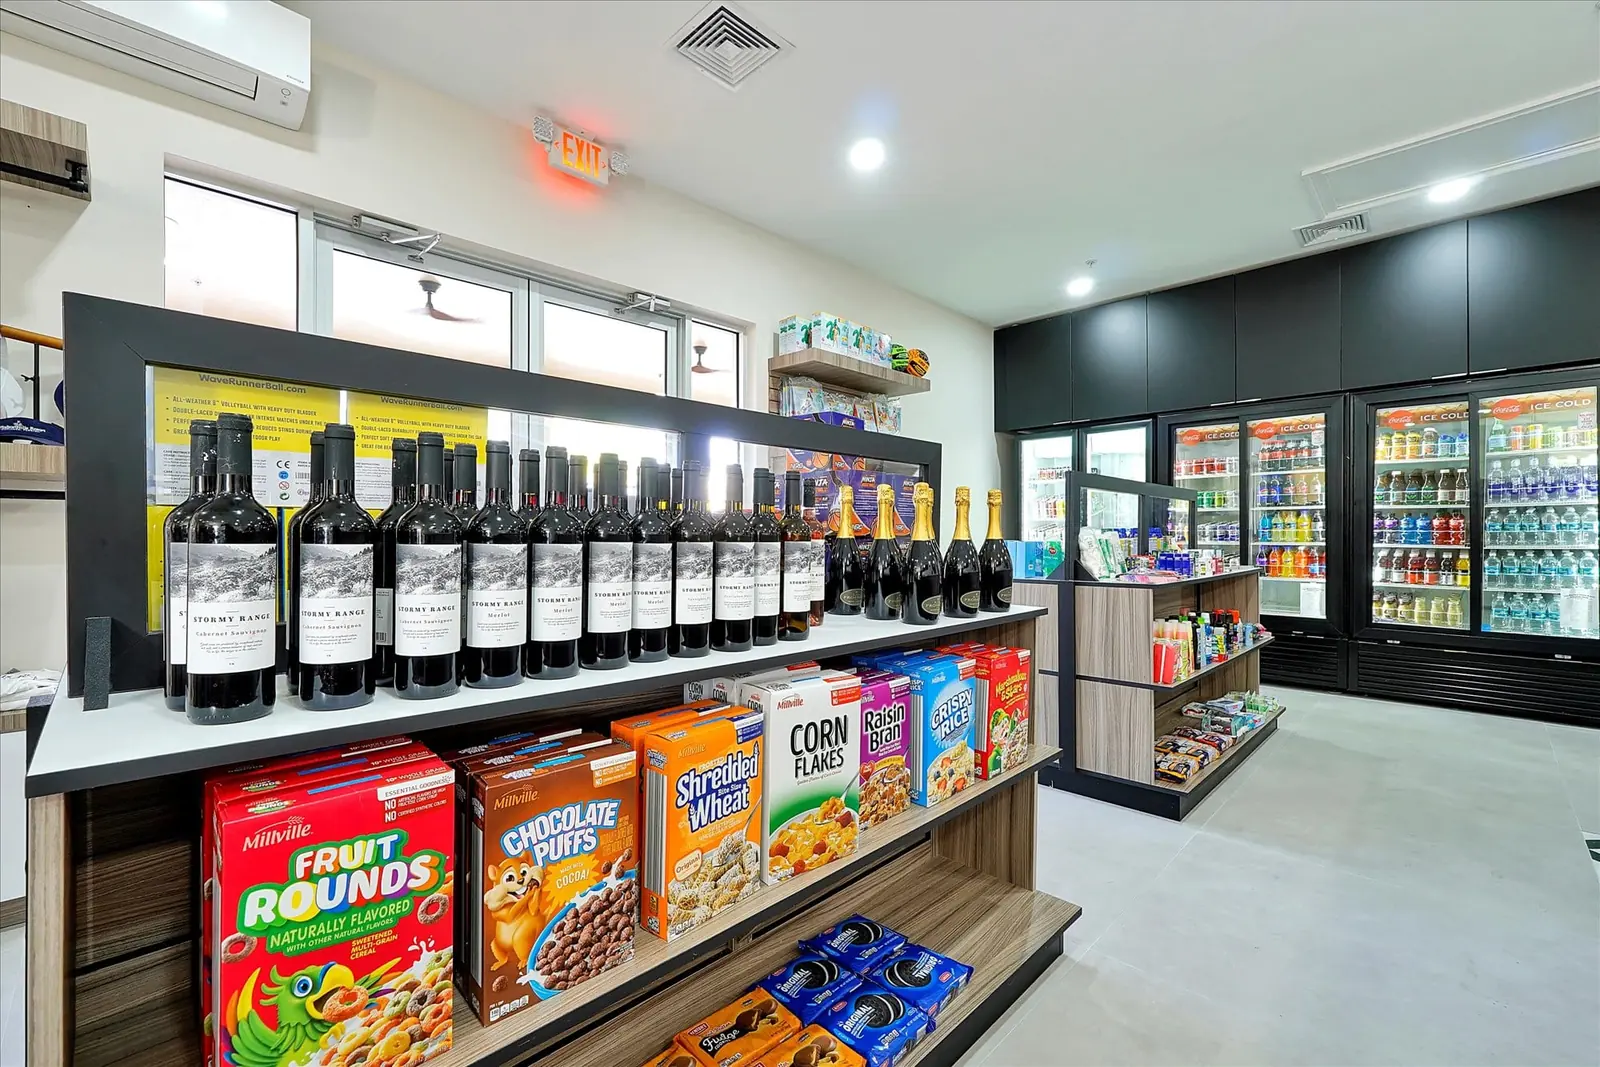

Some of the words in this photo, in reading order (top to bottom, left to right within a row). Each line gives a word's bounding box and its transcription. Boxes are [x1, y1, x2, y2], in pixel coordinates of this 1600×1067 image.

[562, 131, 602, 179] EXIT
[198, 373, 307, 395] WaveRunnerBall.com
[172, 395, 213, 406] ALL-WEATHER
[221, 401, 252, 410] VOLLEYBALL
[252, 404, 267, 412] WITH
[172, 407, 214, 417] DOUBLE-LACED
[1530, 401, 1552, 411] ICE
[1555, 398, 1591, 409] COLD
[255, 414, 276, 422] INTENSE
[276, 416, 299, 425] MATCHES
[1420, 413, 1437, 422] ICE
[1440, 411, 1469, 421] COLD
[278, 426, 295, 434] STINGS
[1205, 432, 1218, 440] ICE
[1281, 425, 1296, 433] ICE
[1297, 423, 1321, 431] COLD
[239, 613, 271, 622] RANGE
[301, 610, 331, 618] STORMY
[335, 609, 366, 617] RANGE
[231, 628, 267, 636] Sauvignon
[688, 681, 704, 696] CORN
[712, 689, 728, 703] CORN
[747, 699, 763, 713] CORN
[777, 697, 804, 710] Millville
[931, 688, 973, 730] CRISPY
[864, 703, 905, 732] Raisin
[941, 707, 969, 740] RICE
[790, 714, 848, 756] CORN
[870, 723, 901, 752] Bran
[408, 751, 429, 759] GRAIN
[678, 744, 706, 759] Millville
[795, 747, 844, 778] FLAKES
[399, 772, 423, 780] WHOLE
[424, 767, 447, 775] GRAIN
[677, 752, 758, 808] Shredded
[385, 785, 419, 798] ESSENTIAL
[419, 778, 449, 789] GOODNESS
[718, 787, 730, 796] Bite
[730, 783, 742, 791] Size
[385, 799, 397, 811] NO
[494, 790, 538, 811] Millville
[690, 783, 749, 832] Wheat
[385, 811, 397, 823] NO
[433, 799, 447, 807] COLORS
[242, 823, 311, 852] Millville
[503, 801, 618, 854] CHOCOLATE
[296, 833, 399, 879] FRUIT
[533, 828, 597, 867] PUFFS
[676, 853, 701, 873] Original
[556, 868, 589, 889] COCOA!
[243, 854, 434, 927] ROUNDS
[269, 916, 347, 949] NATURALLY
[350, 899, 410, 927] FLAVORED
[286, 942, 304, 954] WITH
[304, 936, 333, 950] OTHER
[333, 927, 365, 943] NATURAL
[365, 918, 395, 933] FLAVORS
[350, 934, 399, 954] MULTI-GRAIN
[351, 930, 394, 948] SWEETENED
[831, 928, 856, 947] ORIGINAL
[350, 946, 377, 960] CEREAL
[781, 968, 810, 993] ORIGINAL
[843, 1003, 873, 1032] ORIGINAL
[702, 1029, 740, 1052] Fudge
